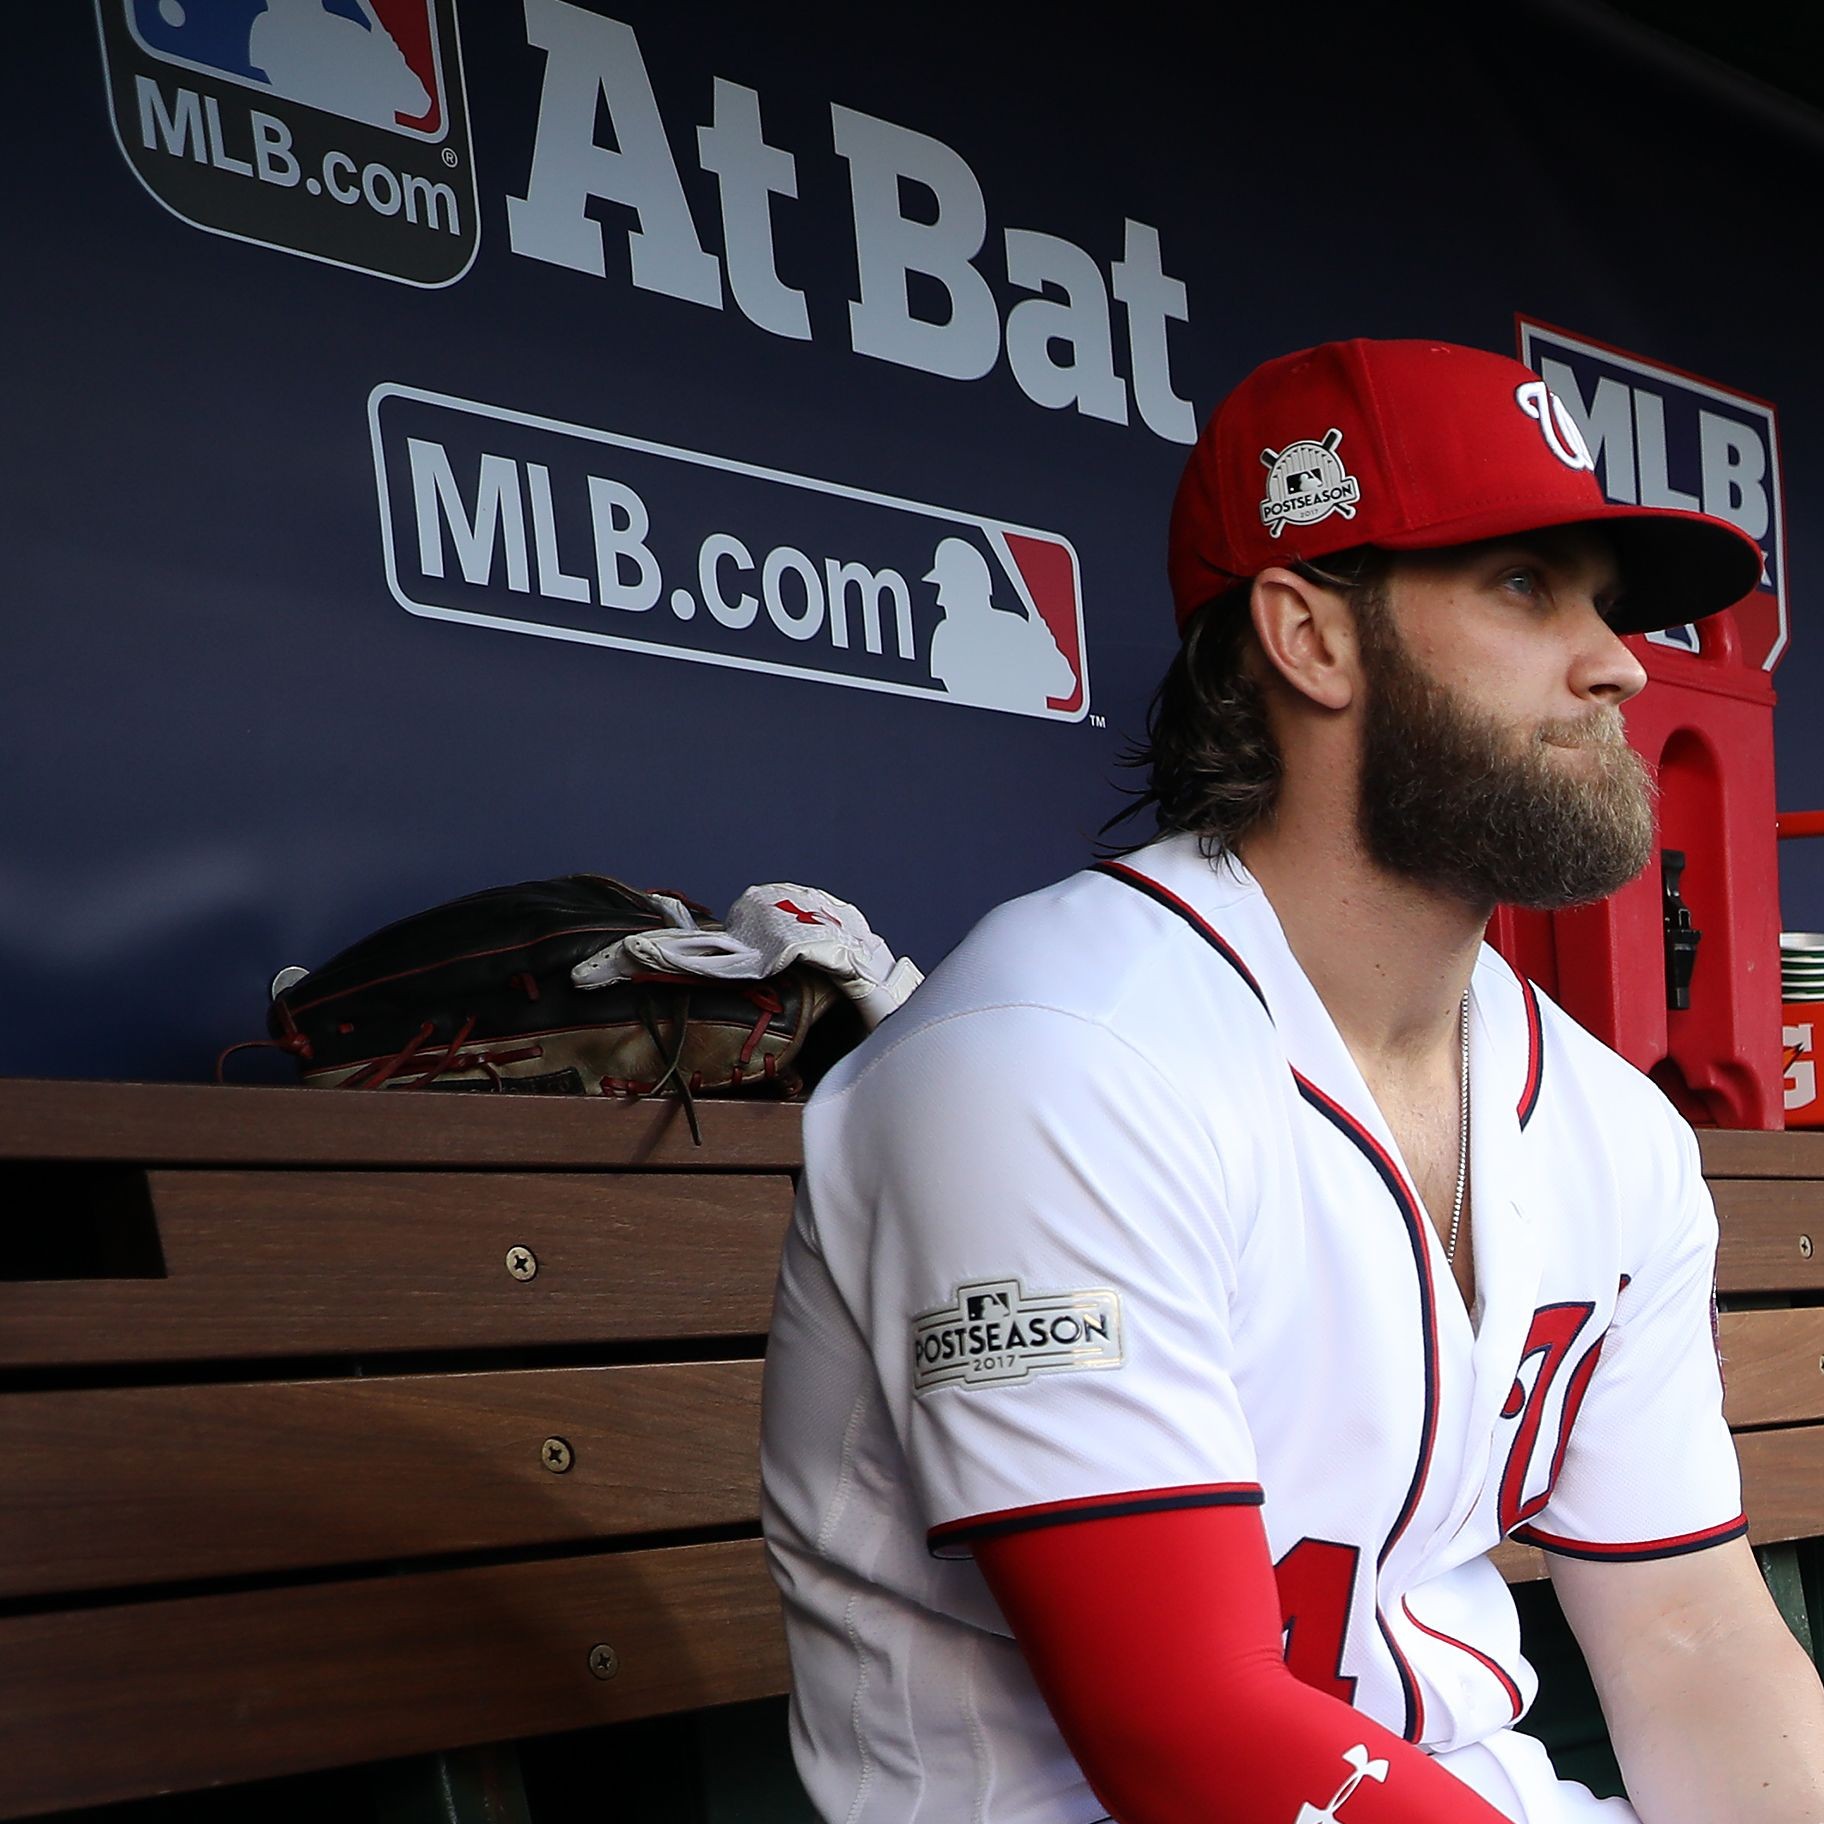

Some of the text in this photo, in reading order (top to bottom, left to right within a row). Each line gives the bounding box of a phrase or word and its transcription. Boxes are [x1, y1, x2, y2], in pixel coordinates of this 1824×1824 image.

[135, 73, 461, 237] MLB.com
[506, 0, 1199, 446] At Bat
[1264, 484, 1353, 519] POSTSEASON
[1541, 356, 1769, 541] MLB
[406, 437, 917, 661] MLB.com
[1300, 508, 1319, 518] 2017
[916, 1314, 1110, 1368] POSTSEASON
[973, 1354, 1016, 1372] 2017
